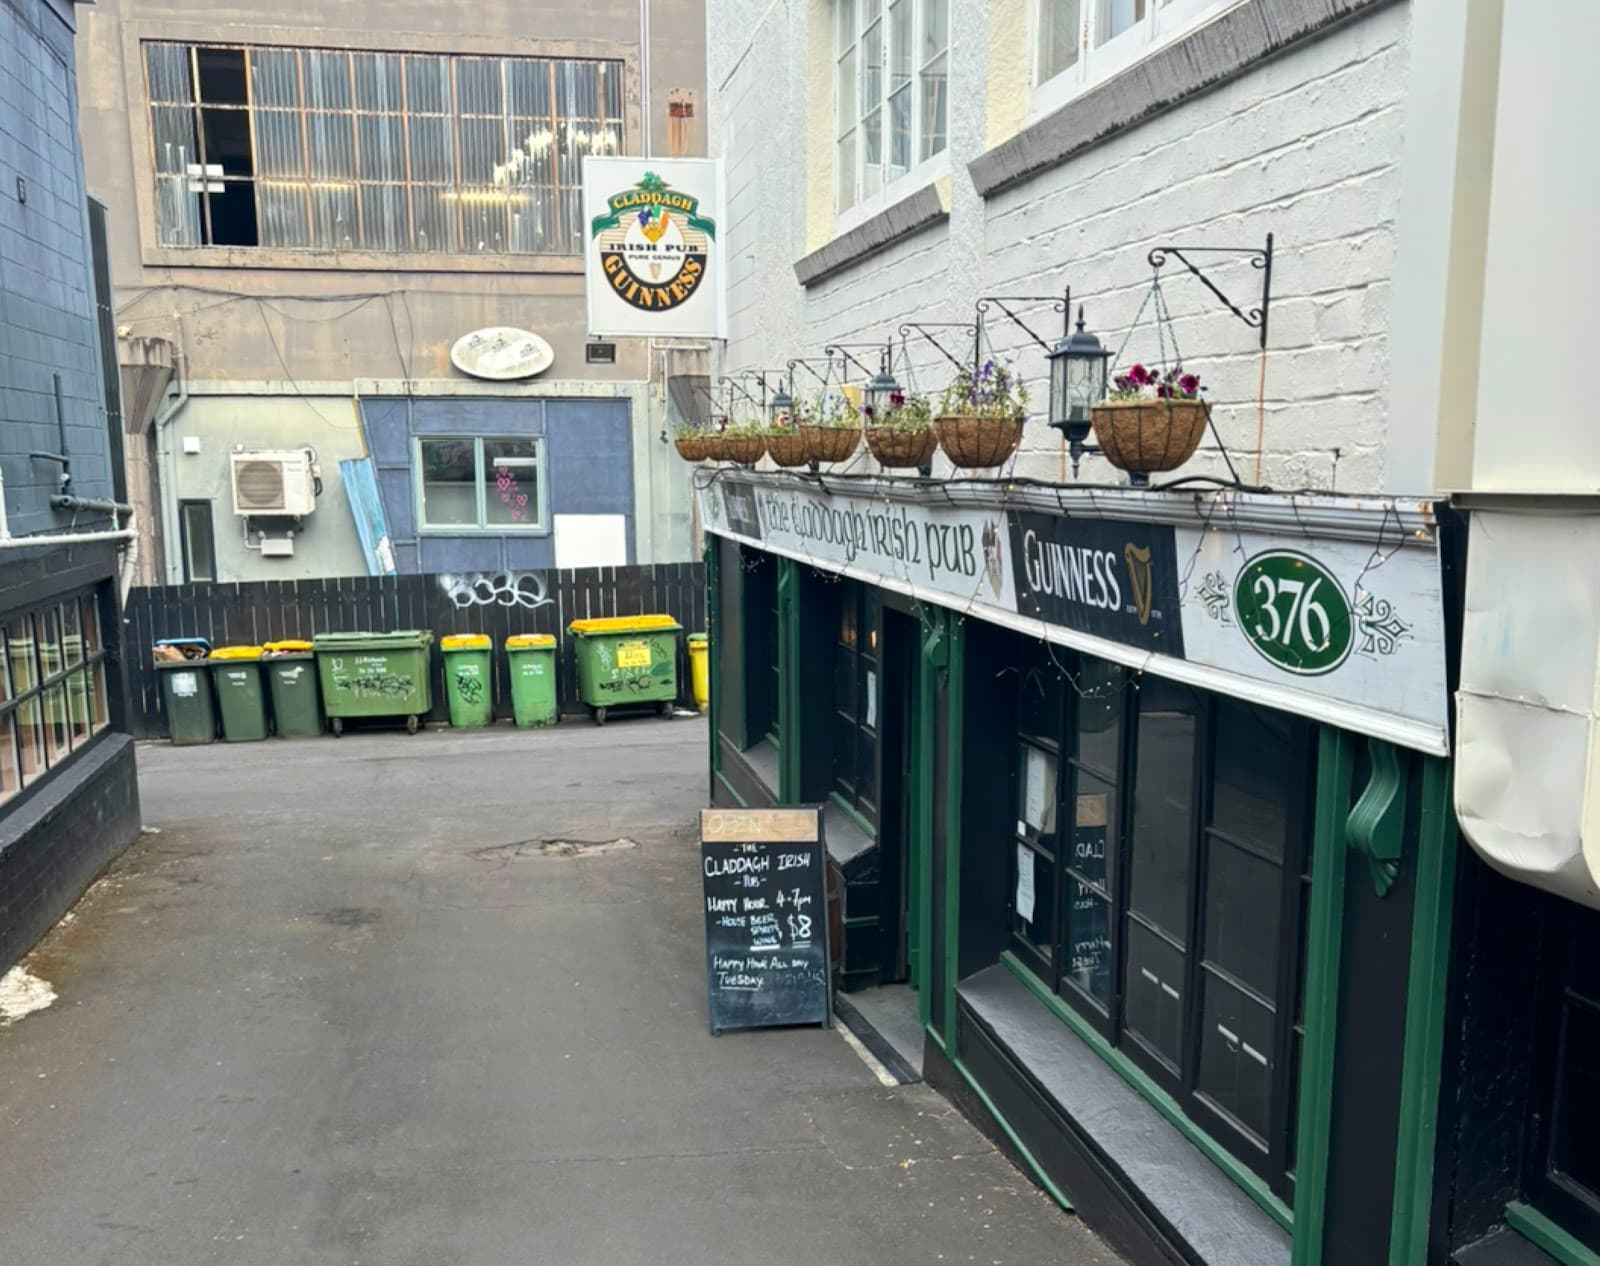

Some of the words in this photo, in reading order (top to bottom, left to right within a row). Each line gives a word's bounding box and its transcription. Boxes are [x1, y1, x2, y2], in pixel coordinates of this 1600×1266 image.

[613, 191, 693, 210] CLADDAGH
[609, 242, 657, 251] IRISH
[665, 244, 698, 252] PUB
[605, 255, 702, 307] GUINNESS
[1023, 528, 1121, 612] GUINNESS
[1252, 574, 1331, 653] 376
[704, 855, 770, 877] CLADDAGH
[777, 852, 811, 870] IRISH
[787, 914, 812, 940] $8
